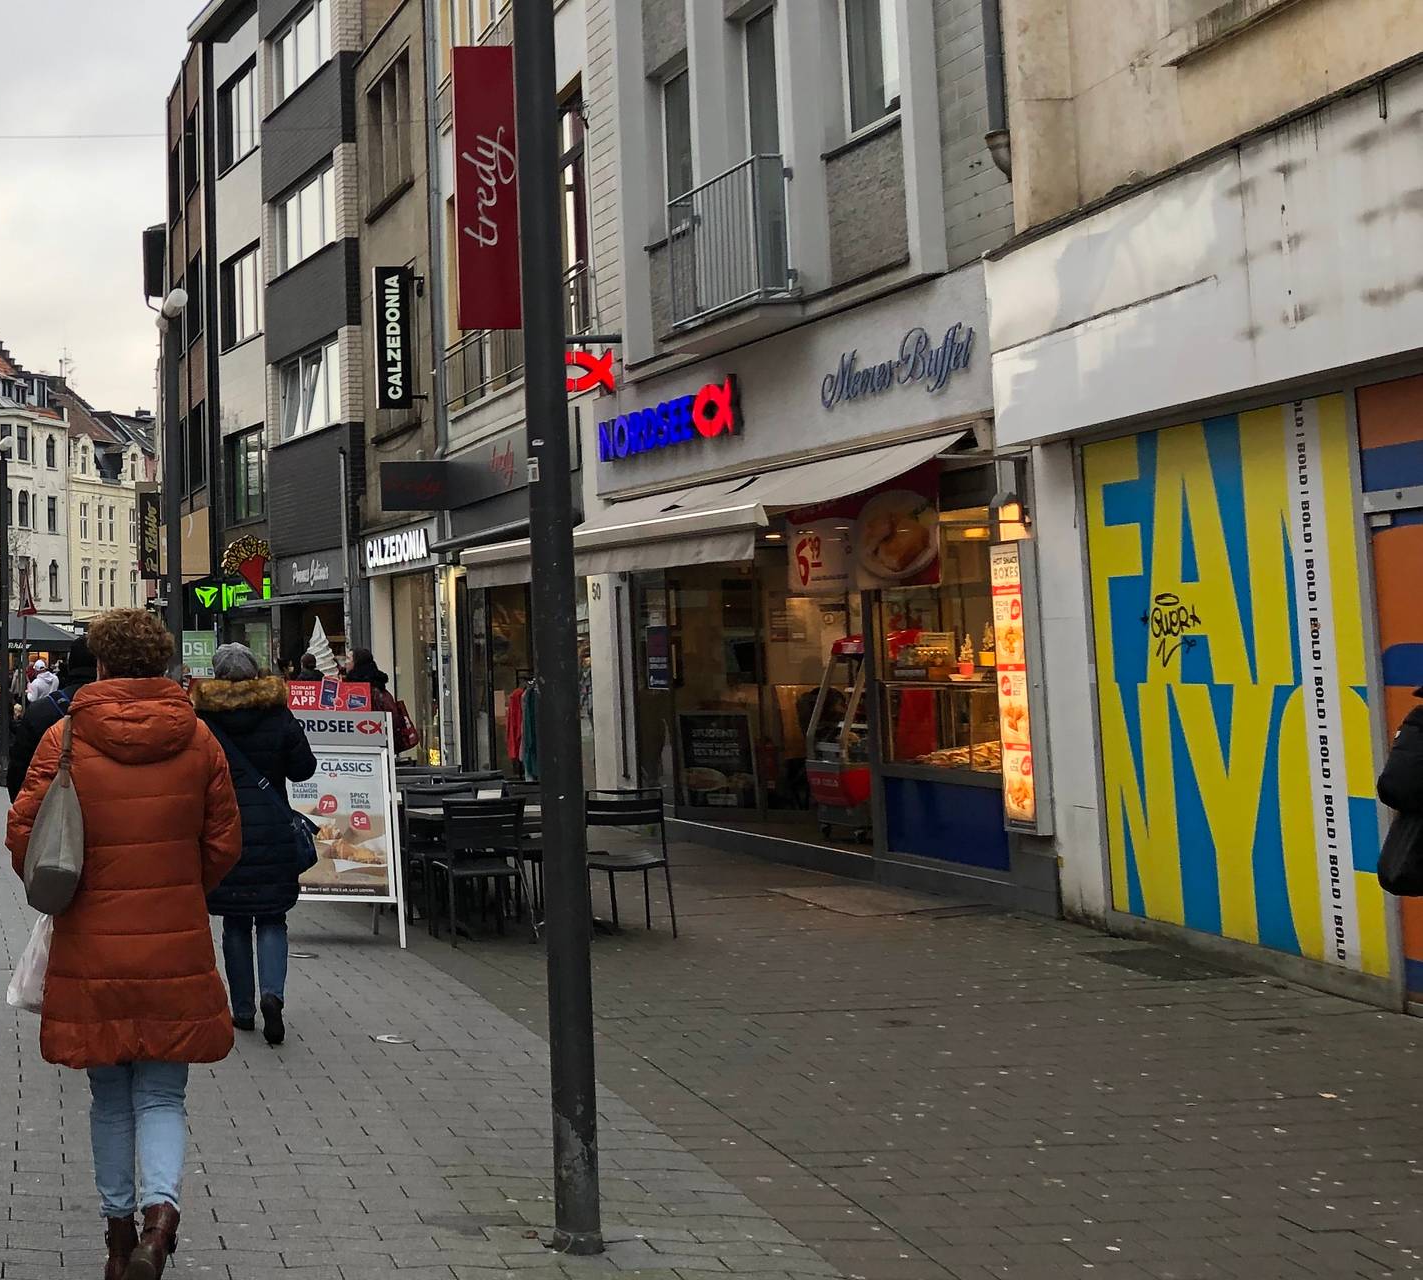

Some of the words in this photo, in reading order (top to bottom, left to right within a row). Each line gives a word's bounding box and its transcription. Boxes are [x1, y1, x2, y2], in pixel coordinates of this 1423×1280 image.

[462, 126, 518, 248] tredy
[385, 274, 404, 400] CALZEDONIA
[599, 395, 694, 462] NORDSEE
[1297, 443, 1308, 486] BOLD
[1301, 500, 1313, 544] BOLD
[366, 528, 428, 568] CALZEDONIA
[1305, 558, 1317, 602] BOLD
[1309, 617, 1321, 661] BOLD
[291, 696, 316, 706] APP
[1314, 675, 1326, 720] BOLD
[299, 719, 355, 733] ORDSEE
[321, 762, 373, 773] CLASSICS
[1318, 734, 1331, 779] BOLD
[1323, 793, 1336, 840] BOLD
[1328, 854, 1341, 899] BOLD
[1333, 915, 1346, 961] BOLD
